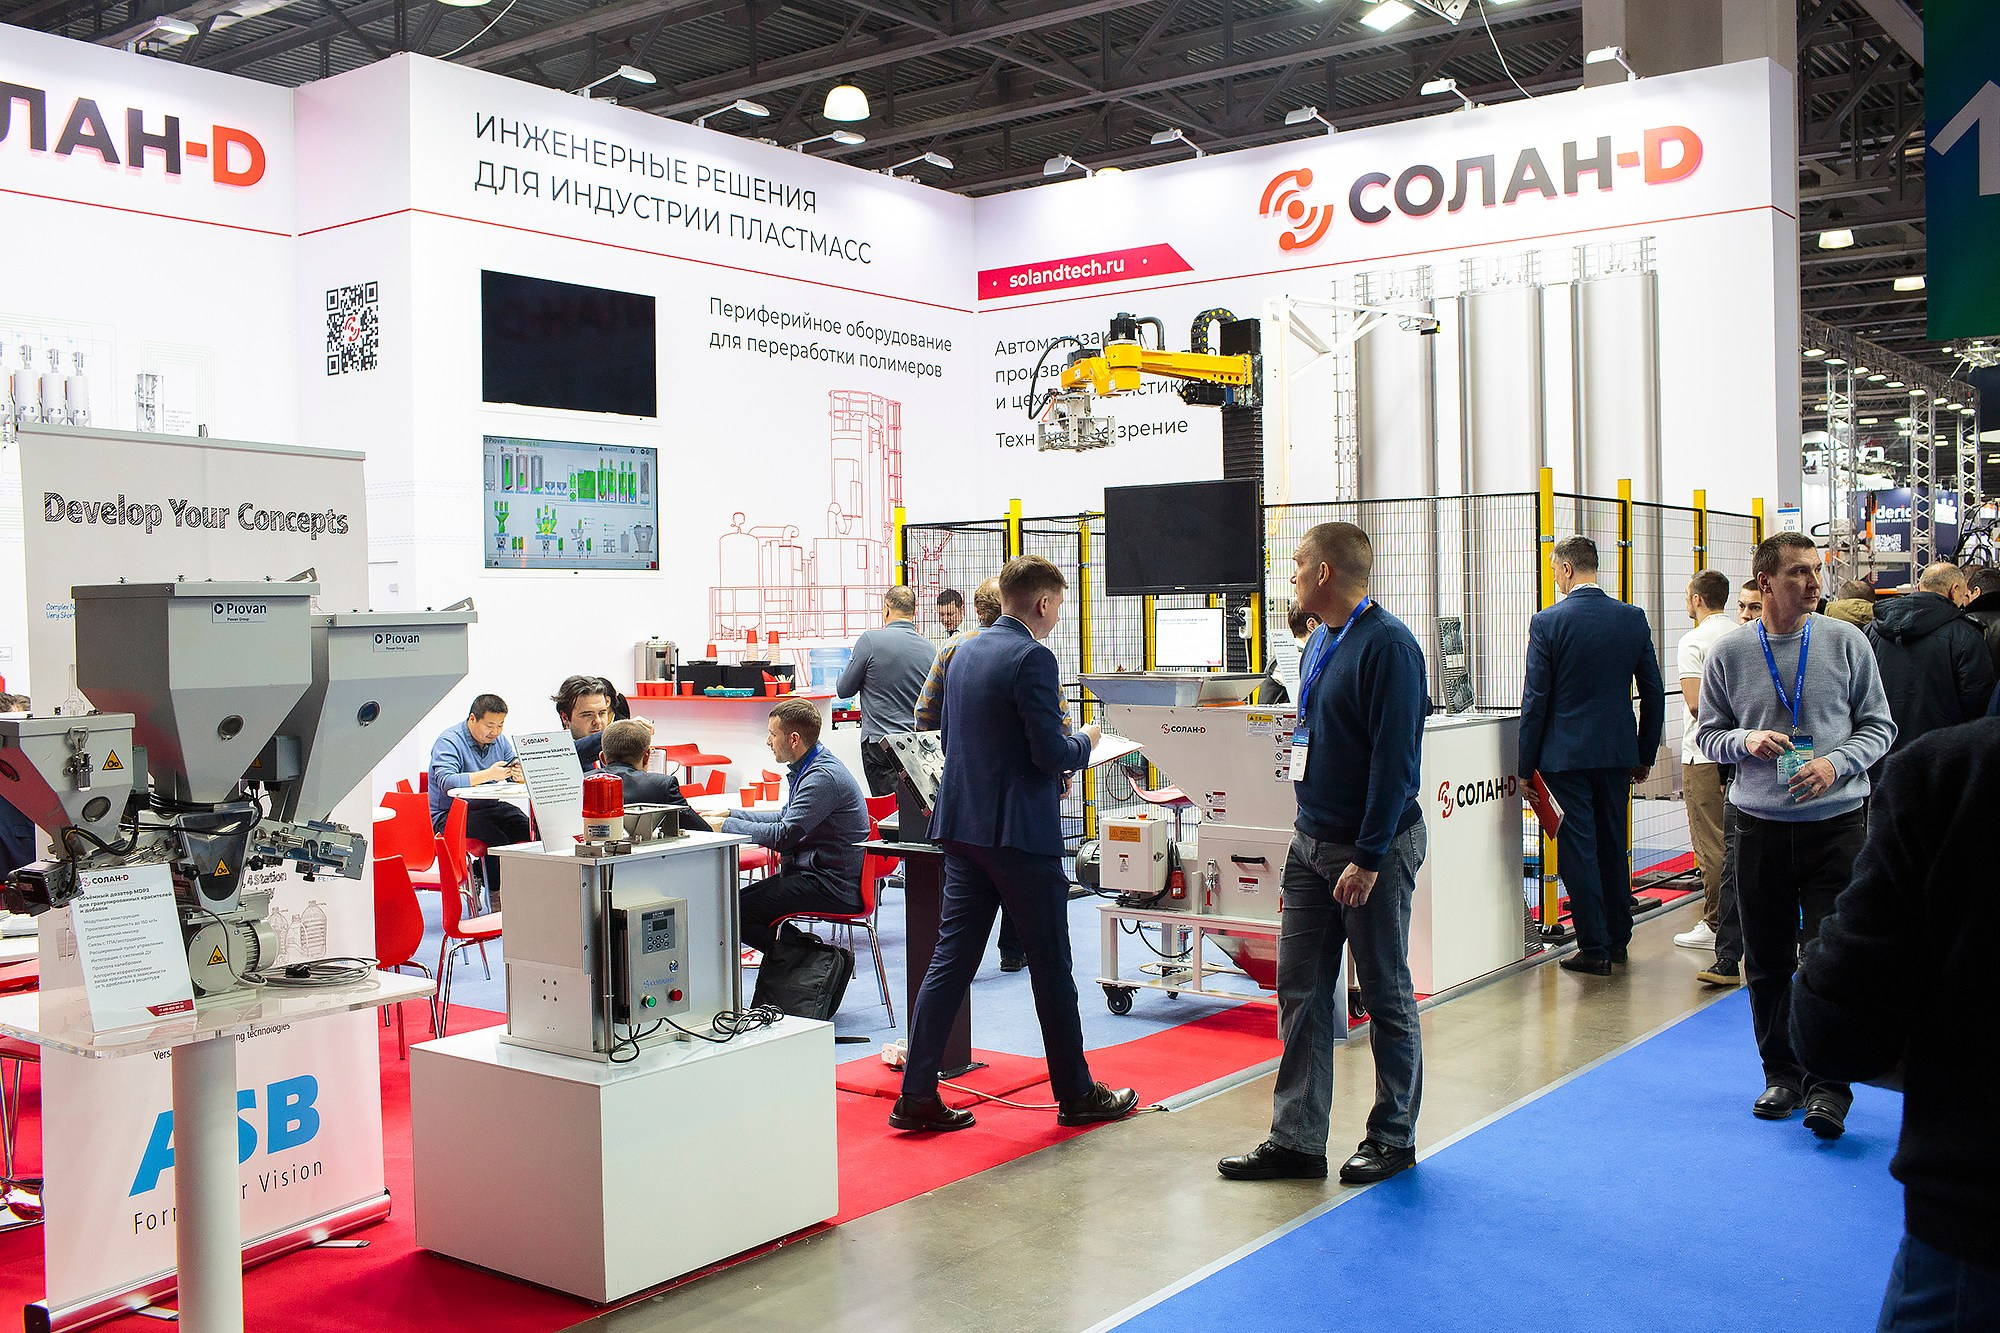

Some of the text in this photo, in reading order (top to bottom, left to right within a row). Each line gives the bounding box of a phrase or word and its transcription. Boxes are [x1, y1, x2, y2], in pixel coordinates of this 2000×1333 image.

[475, 111, 816, 214] ИНЖЕНЕРНЫЕ РЕШЕНИЯ
[1349, 125, 1704, 224] СОЛАН-D
[474, 160, 873, 265] ДЛЯ ИНДУСТРИИ ПЛАСТМАСС
[1009, 258, 1125, 288] solandtech.ru
[709, 296, 953, 353] Периферийное оборудование
[994, 331, 1105, 357] Автоматиза
[709, 332, 944, 379] для переработки полимеров
[996, 397, 1006, 410] и
[1117, 420, 1188, 442] зрение
[43, 491, 349, 541] Develop Your Concepts
[45, 602, 69, 611] Complex
[45, 611, 60, 620] Very
[226, 602, 267, 614] Piovan
[385, 633, 420, 644] Piovan
[1171, 725, 1206, 734] СОЛАН-D
[1456, 775, 1517, 808] СОЛАН-D
[91, 874, 130, 885] СОЛАН-D
[254, 870, 288, 886] Station
[140, 891, 173, 901] красителей
[153, 1049, 173, 1061] Vers
[258, 1160, 323, 1193] Vision
